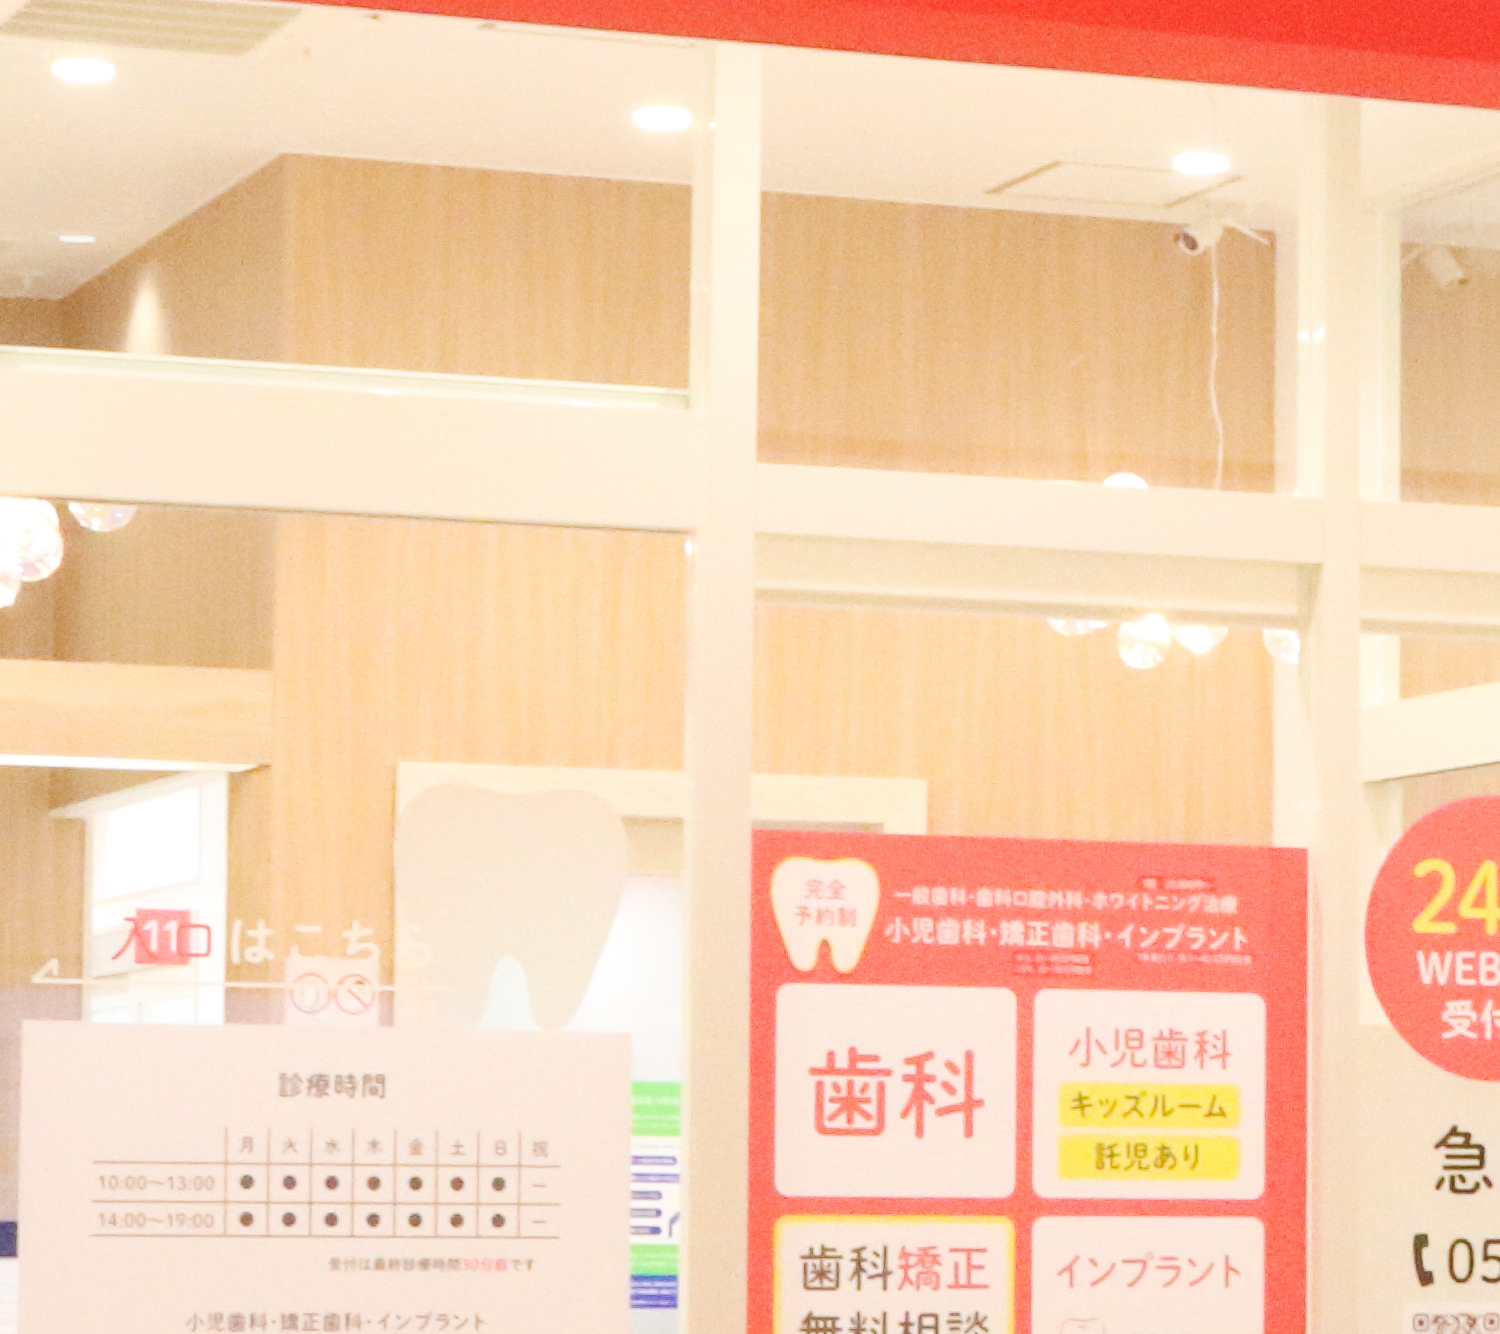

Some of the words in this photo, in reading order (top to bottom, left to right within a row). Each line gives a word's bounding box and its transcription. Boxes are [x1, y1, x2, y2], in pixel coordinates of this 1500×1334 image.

[803, 879, 847, 901] 完全
[794, 905, 857, 929] 予約制
[1068, 1026, 1233, 1072] 小児歯科
[277, 1072, 388, 1101] 診療時間
[809, 1045, 986, 1140] 歯科
[1068, 1090, 1230, 1122] キッズルーム
[240, 1135, 255, 1154] 月
[408, 1138, 424, 1156] 金
[449, 1139, 467, 1157] 土
[493, 1140, 507, 1157] 日
[1094, 1141, 1202, 1173] 託児あり
[799, 1243, 991, 1294] 歯科矯正
[1056, 1250, 1244, 1292] インプラント
